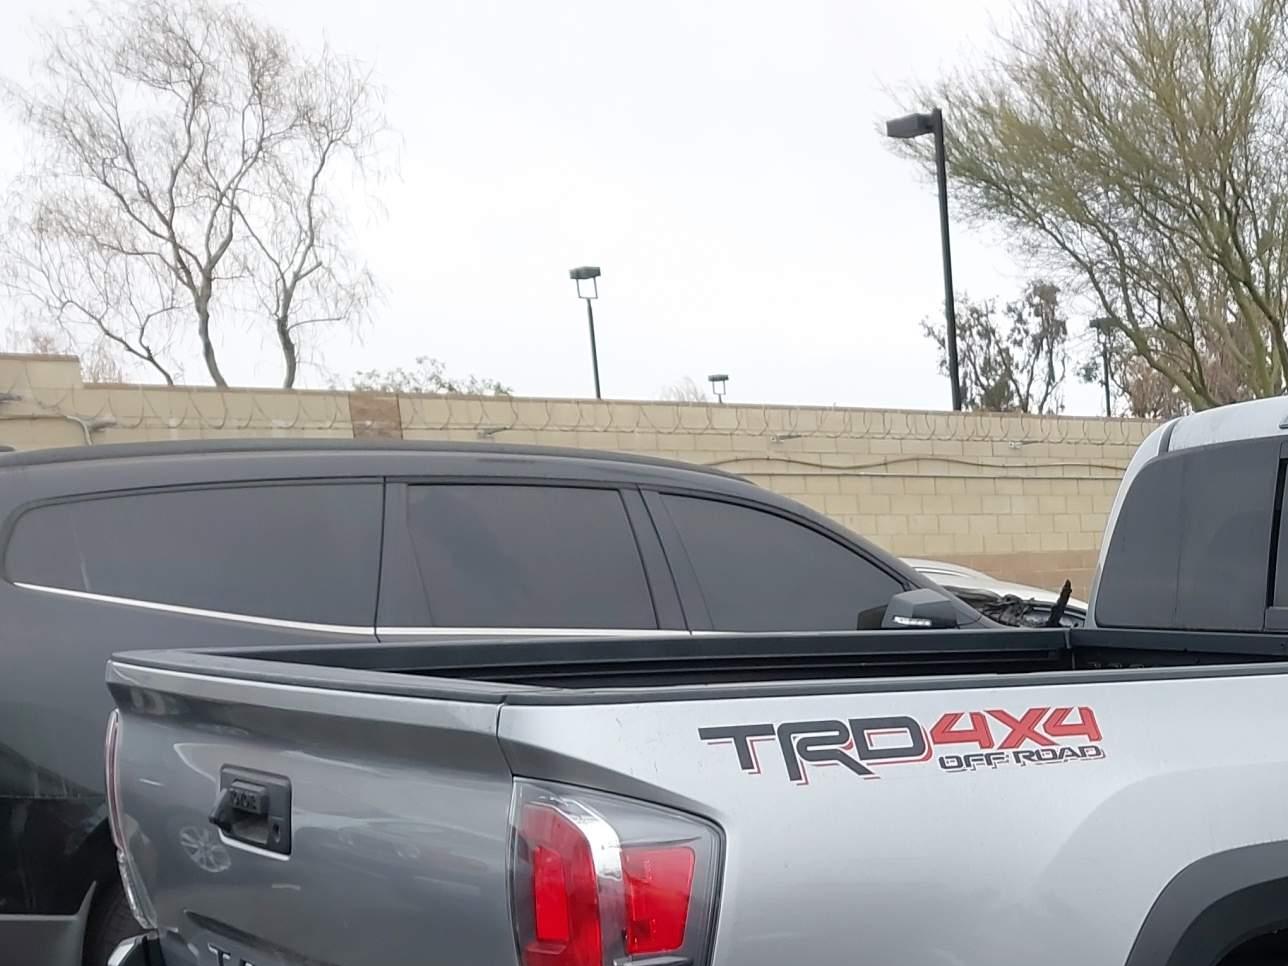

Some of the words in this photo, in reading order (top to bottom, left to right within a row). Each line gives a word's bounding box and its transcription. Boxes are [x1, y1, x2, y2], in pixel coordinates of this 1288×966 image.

[697, 714, 933, 786] TRD
[930, 705, 1103, 750] 4X4
[938, 753, 1007, 773] OFF
[1014, 744, 1105, 767] ROAD
